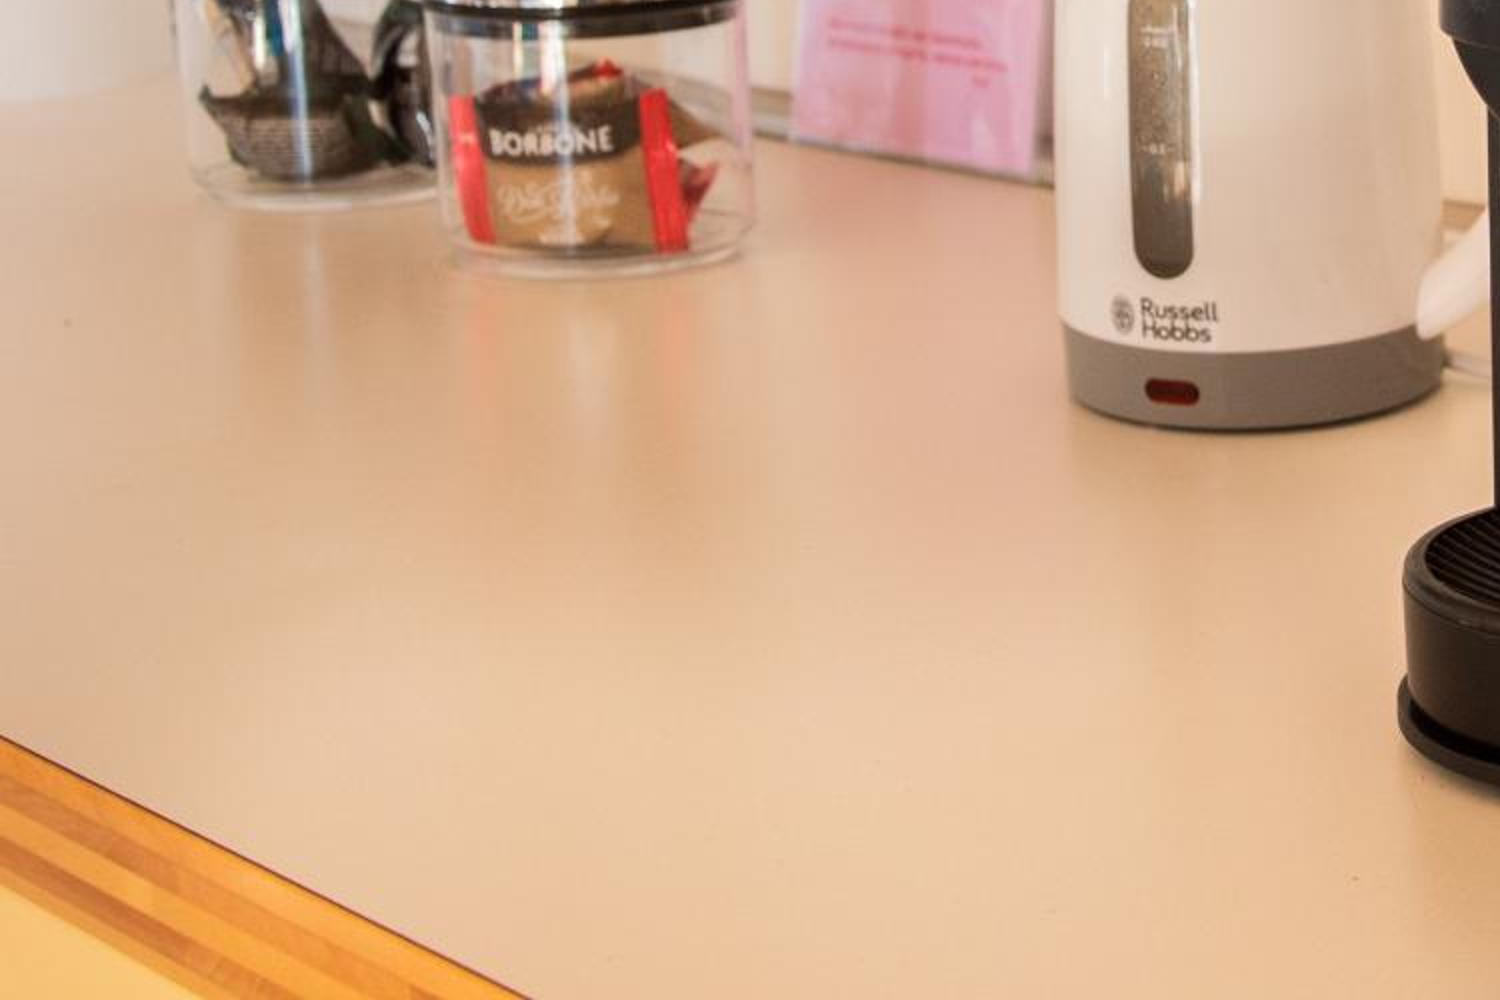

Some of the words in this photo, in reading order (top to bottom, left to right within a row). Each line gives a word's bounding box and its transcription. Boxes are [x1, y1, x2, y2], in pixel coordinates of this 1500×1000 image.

[489, 124, 615, 157] BORBONE
[1140, 297, 1217, 322] Russell
[1142, 320, 1212, 343] Hobbs
